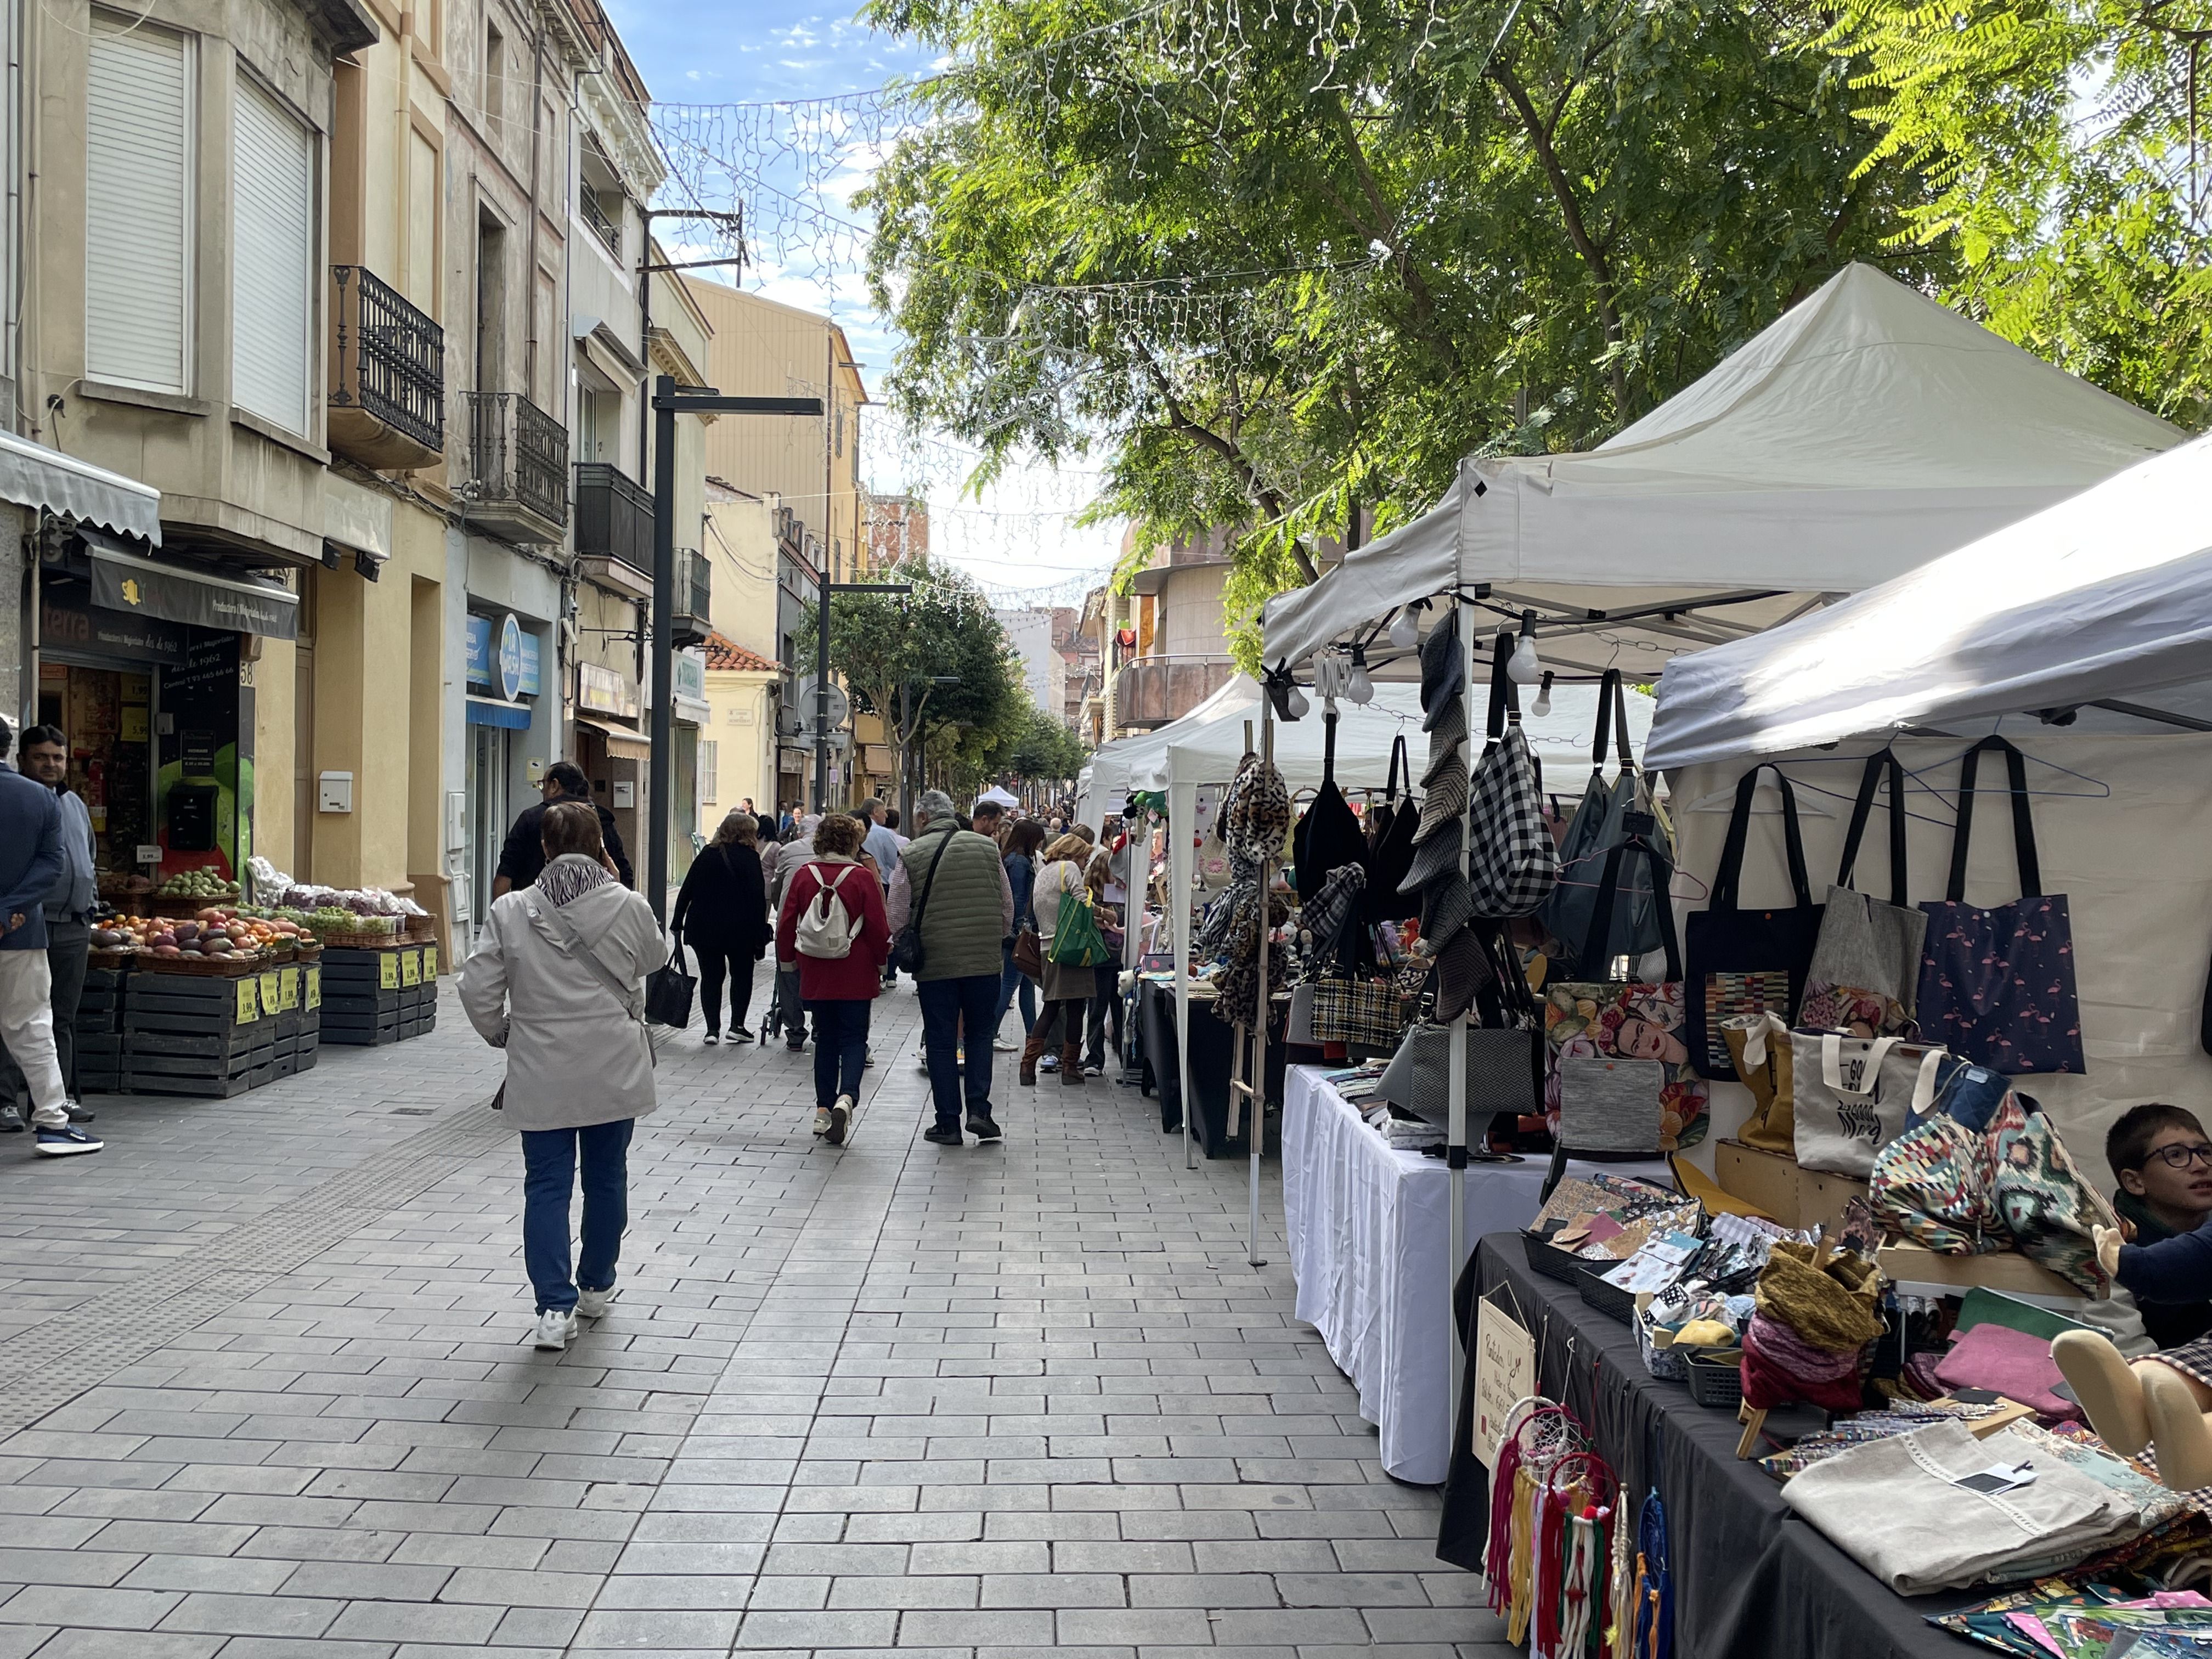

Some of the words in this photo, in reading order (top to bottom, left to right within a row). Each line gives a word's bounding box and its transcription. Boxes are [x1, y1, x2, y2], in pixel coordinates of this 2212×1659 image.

[509, 633, 516, 652] LA
[200, 653, 221, 666] 1962
[503, 653, 520, 676] WASH
[240, 662, 253, 685] 58
